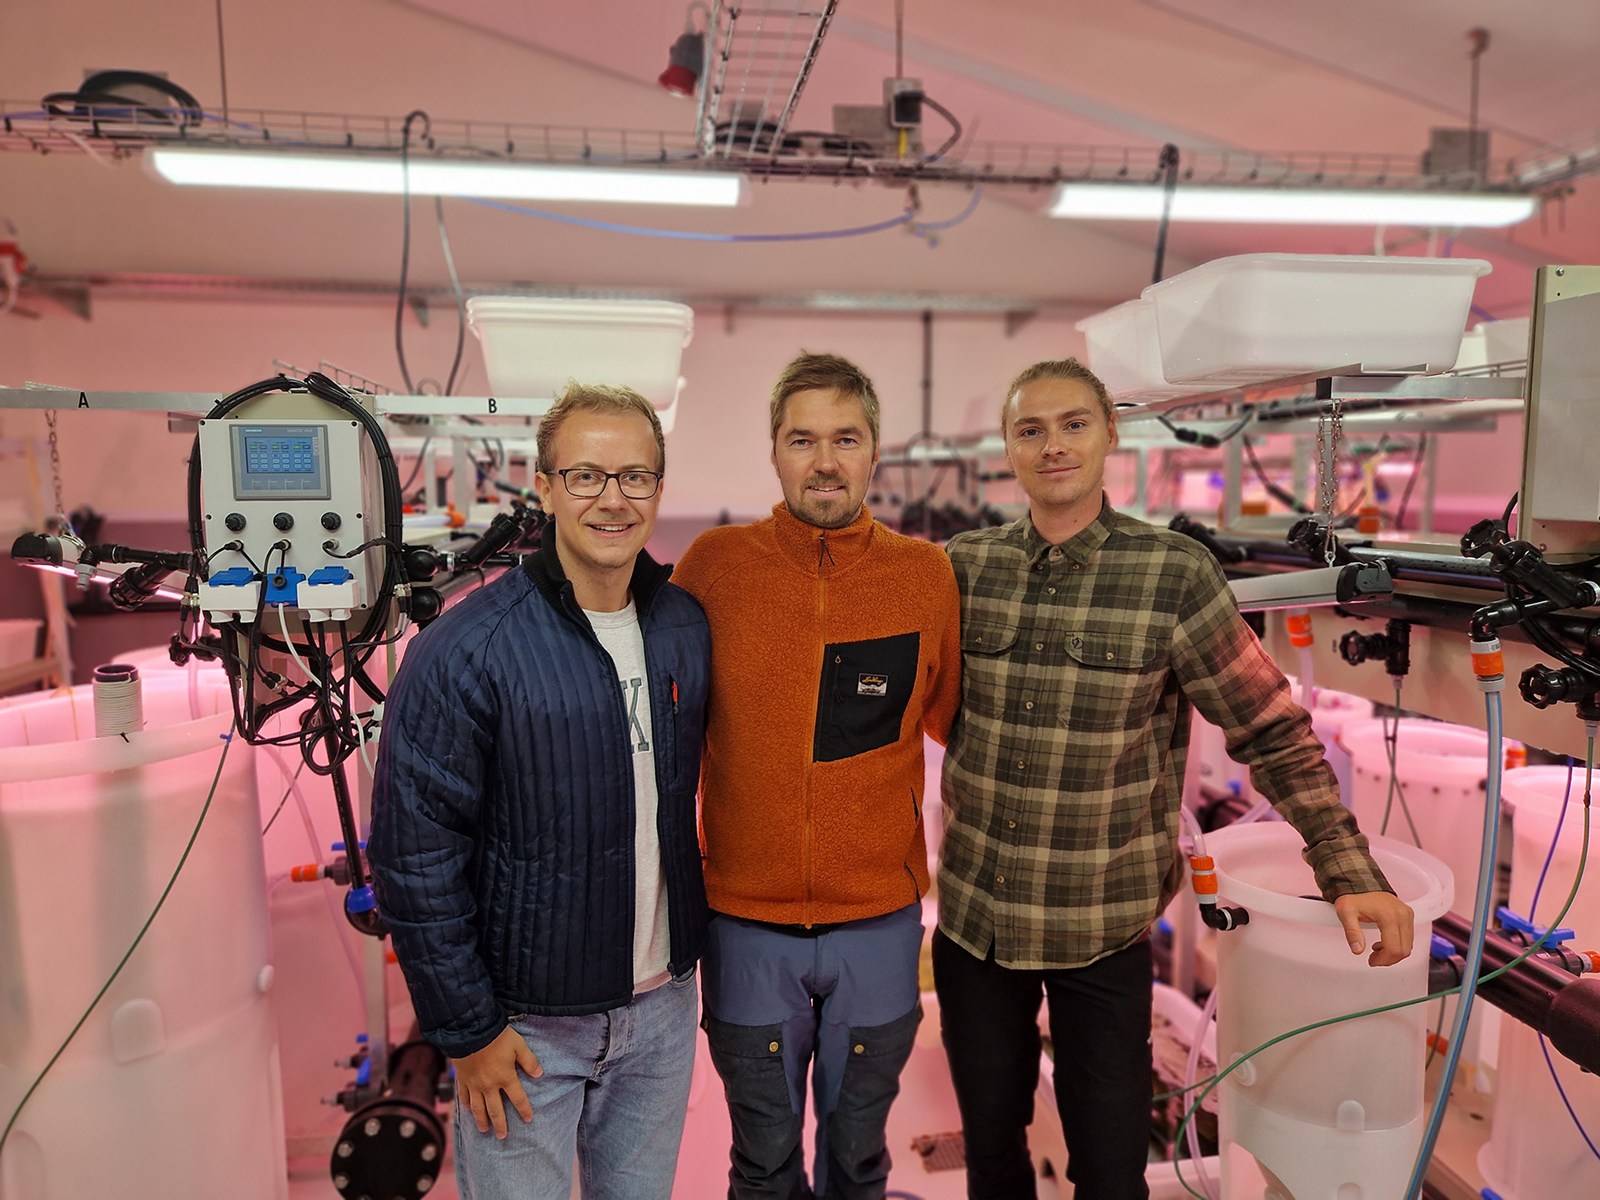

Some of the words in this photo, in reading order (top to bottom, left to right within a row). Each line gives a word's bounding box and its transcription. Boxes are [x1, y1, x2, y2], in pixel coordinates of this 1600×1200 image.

[78, 391, 90, 409] A
[488, 397, 498, 414] B
[620, 677, 650, 753] K
